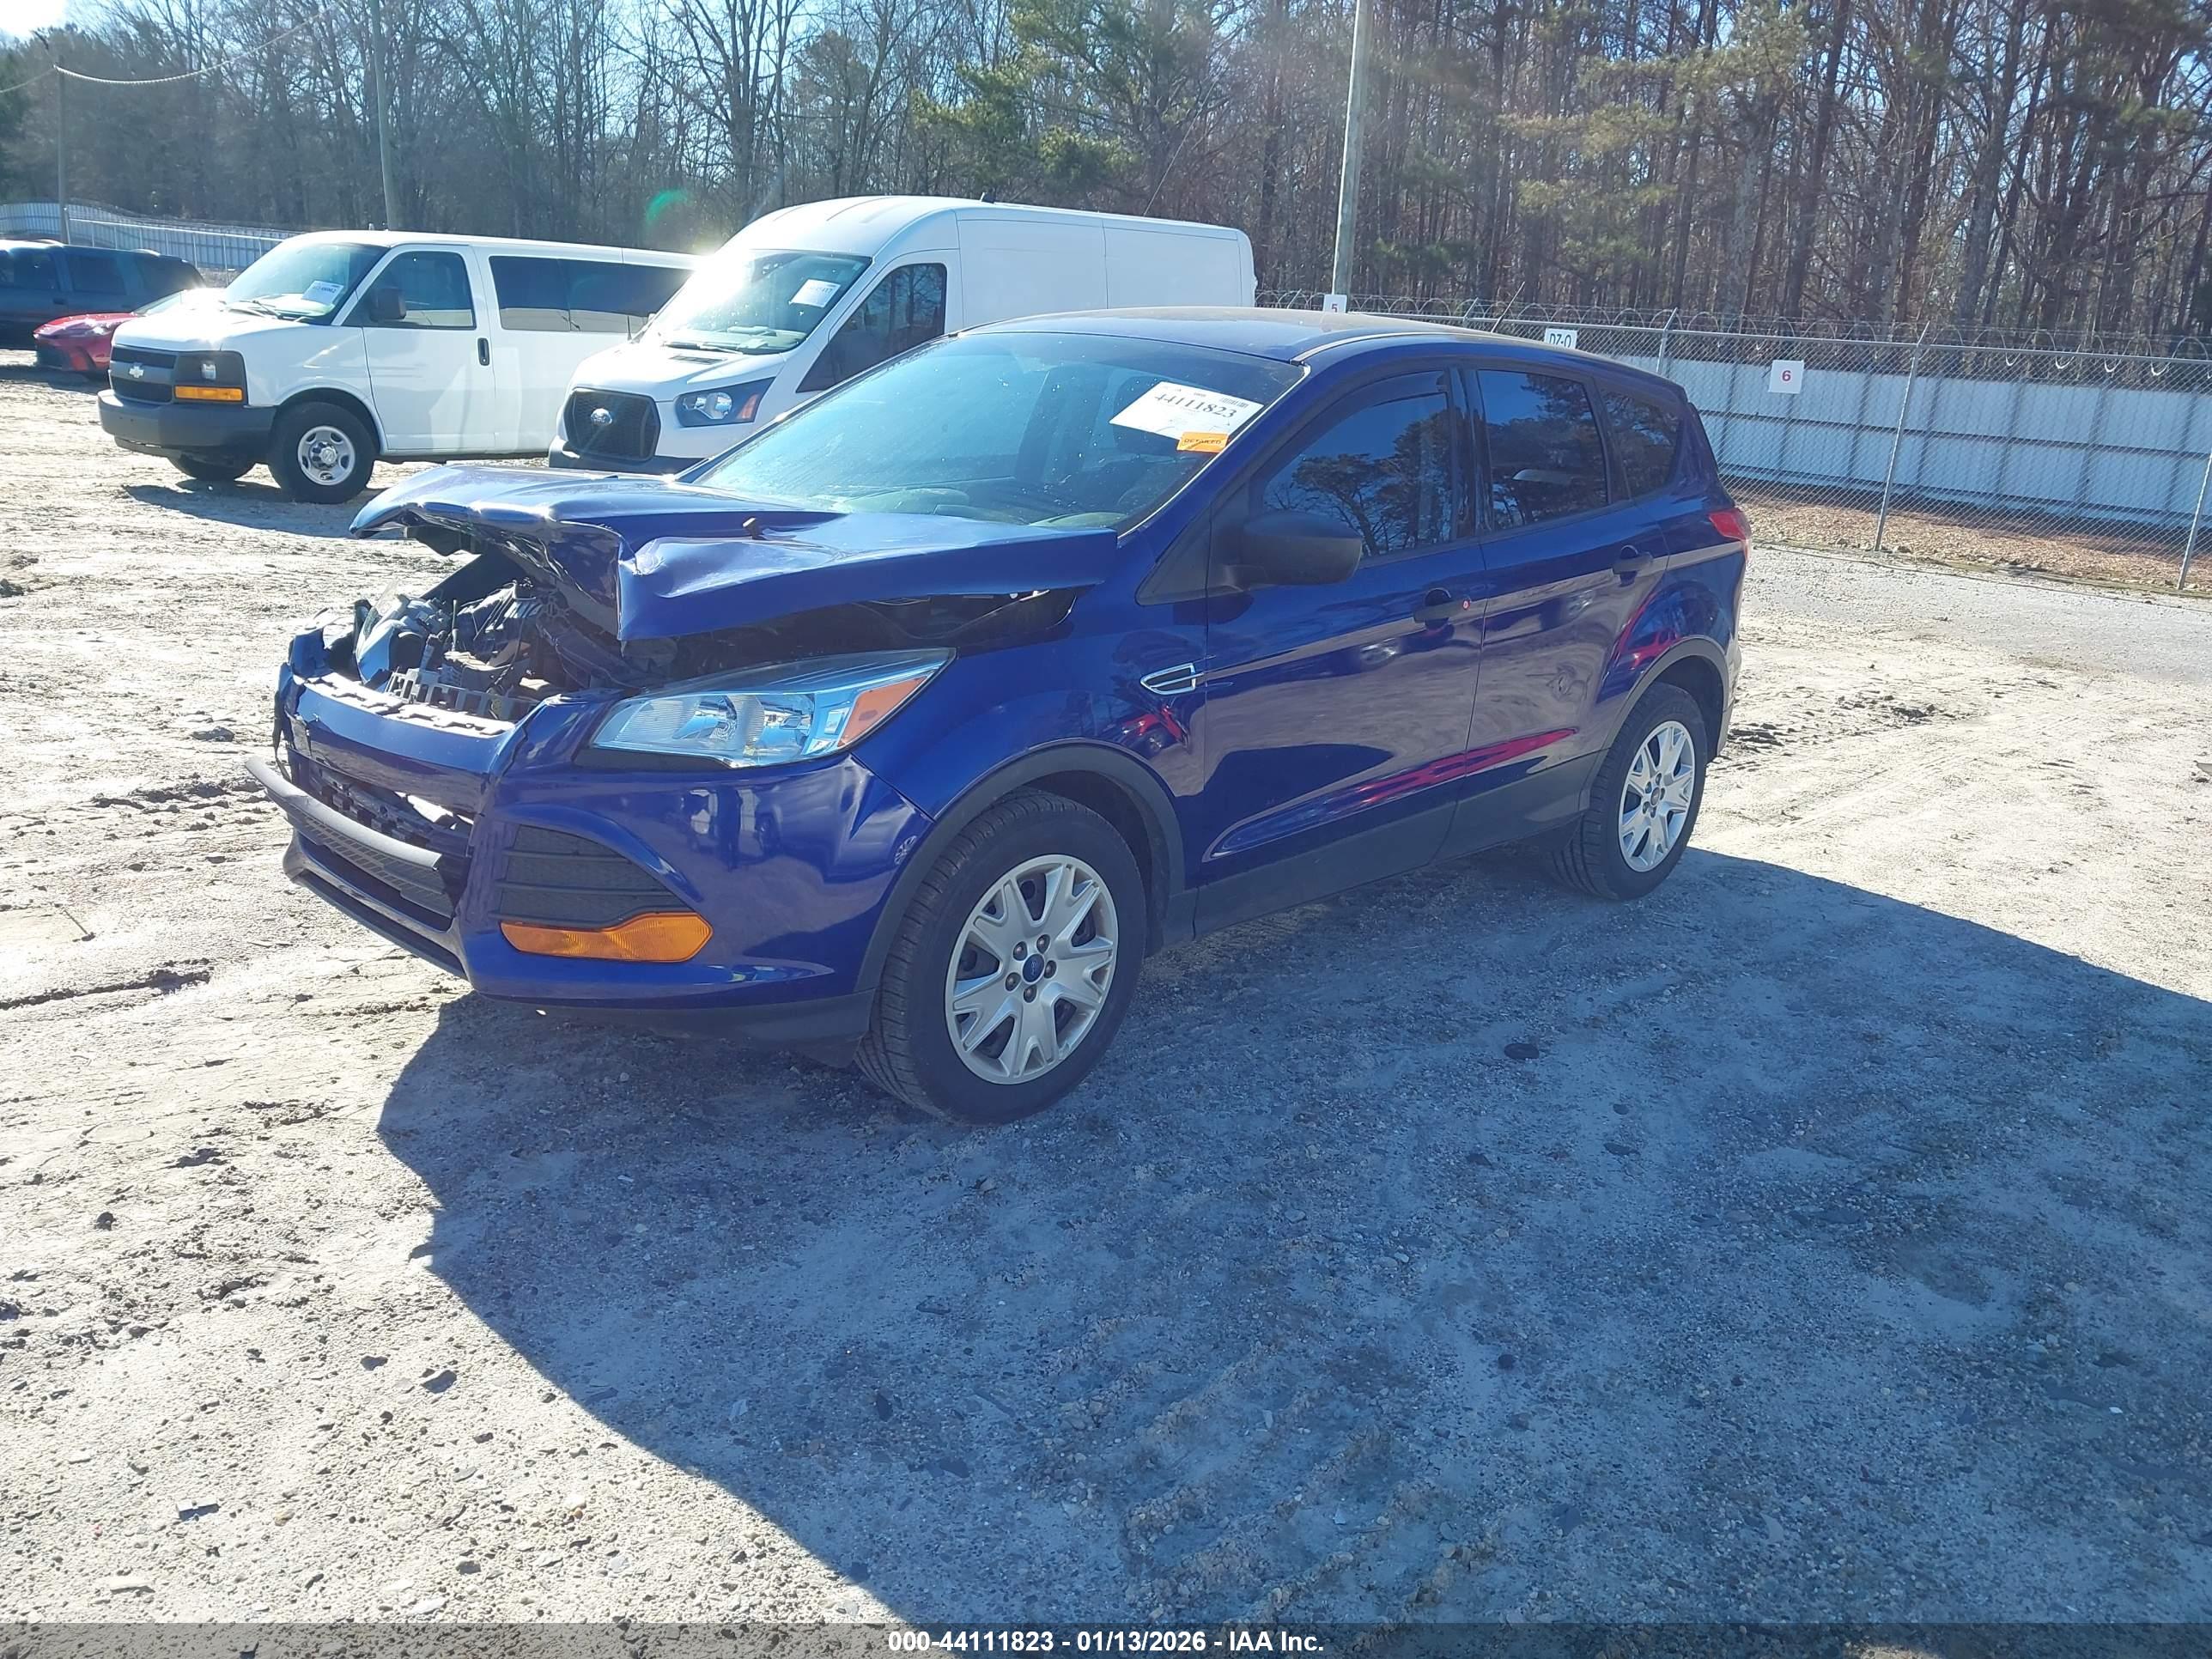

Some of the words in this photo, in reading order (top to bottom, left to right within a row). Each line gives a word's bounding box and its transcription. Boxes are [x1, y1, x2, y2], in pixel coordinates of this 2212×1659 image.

[1331, 303, 1338, 313] 5
[1781, 369, 1792, 382] 6
[1154, 393, 1237, 418] 44111823
